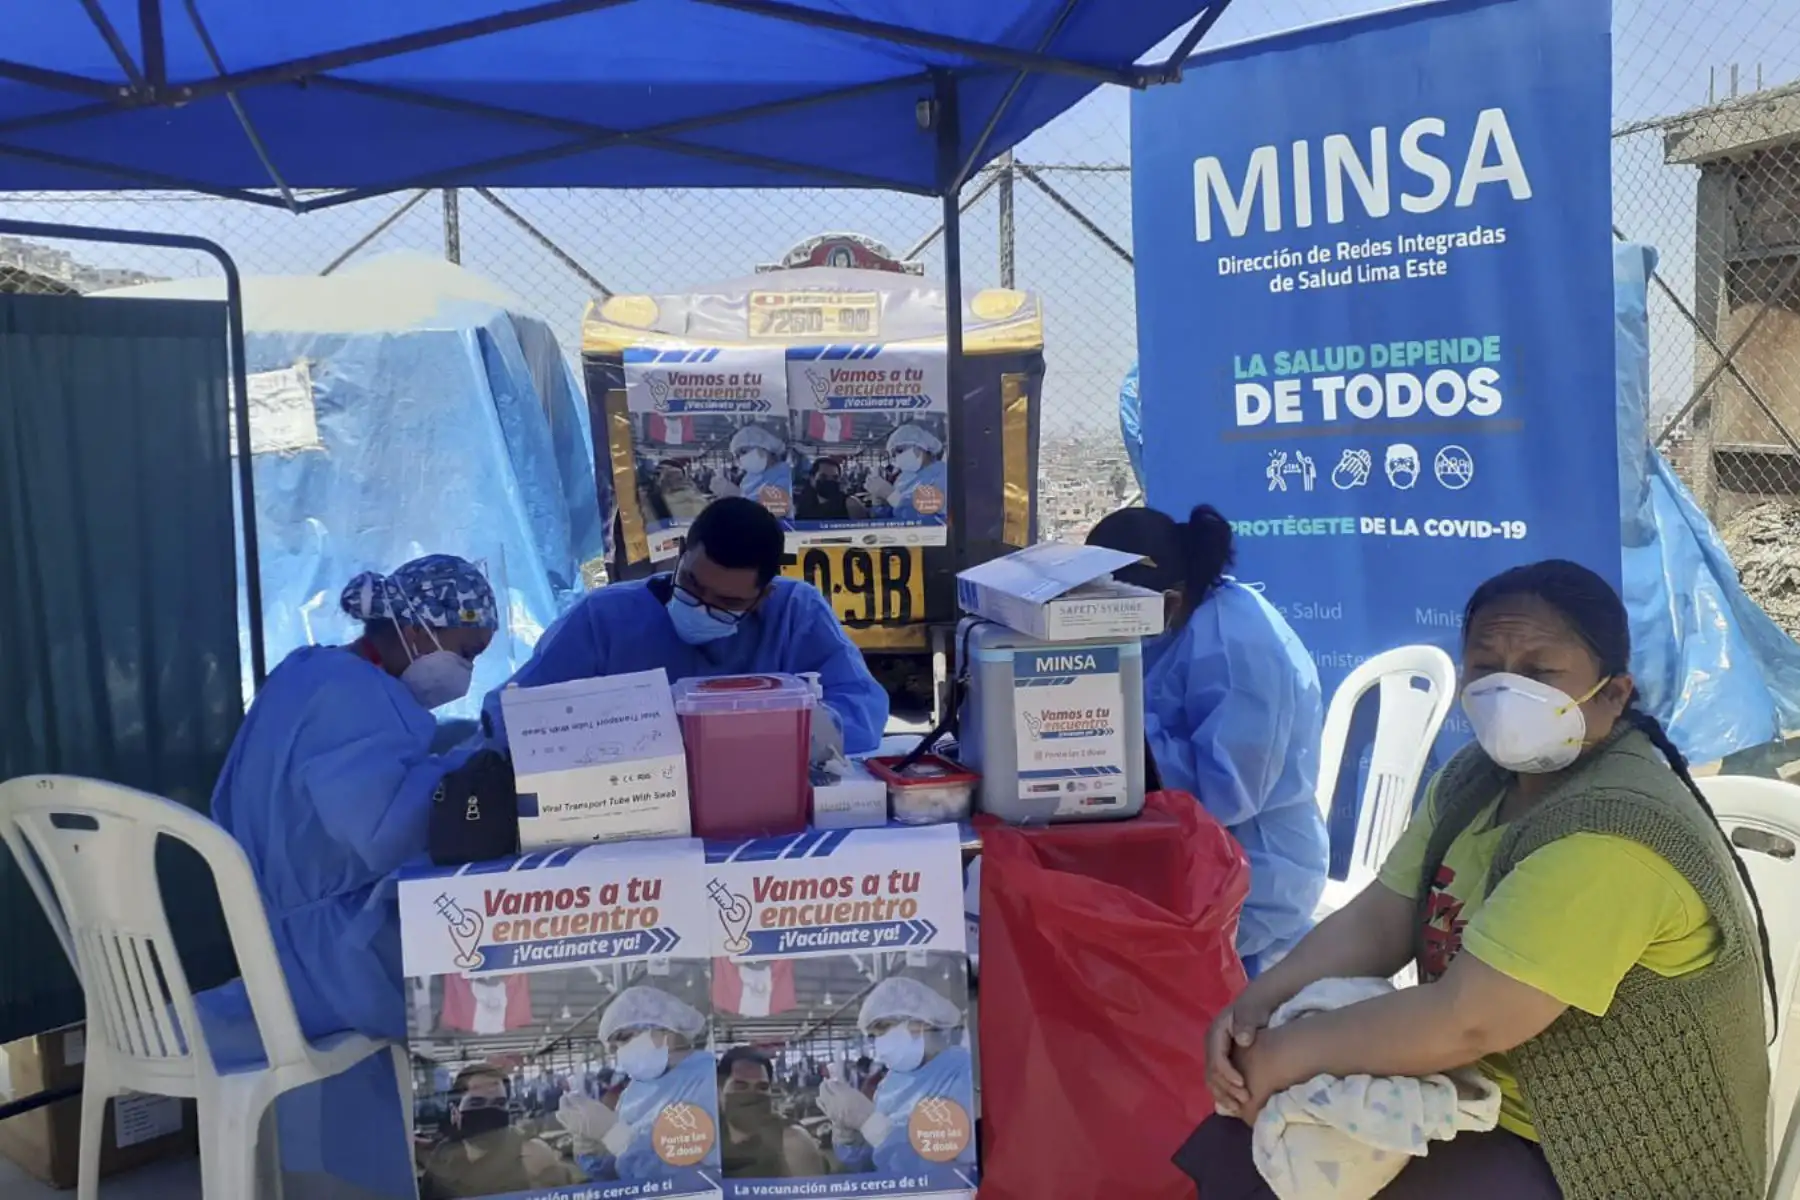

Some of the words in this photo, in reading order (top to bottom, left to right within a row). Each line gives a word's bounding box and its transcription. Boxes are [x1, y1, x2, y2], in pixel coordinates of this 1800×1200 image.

[1193, 107, 1533, 242] MINSA
[1218, 248, 1302, 275] Dirección
[1307, 246, 1331, 264] de
[1337, 239, 1392, 261] Redes
[1398, 226, 1506, 255] Integradas
[1269, 274, 1294, 293] de
[1298, 266, 1353, 290] Salud
[1357, 263, 1400, 284] Lima
[1406, 258, 1448, 278] Este
[1234, 353, 1268, 379] LA
[1273, 345, 1366, 376] SALUD
[1370, 336, 1501, 368] DEPENDE
[667, 371, 725, 386] Vamos
[728, 373, 739, 385] a
[743, 371, 763, 386] tu
[830, 368, 886, 383] Vamos
[890, 369, 901, 381] a
[905, 367, 923, 381] tu
[673, 385, 760, 399] encuentro
[834, 381, 921, 396] encuentro
[1235, 379, 1304, 427] DE
[1312, 367, 1502, 420] TODOS
[1360, 516, 1386, 535] DE
[1390, 518, 1420, 536] LA
[1424, 519, 1527, 539] COVID-19
[1293, 602, 1343, 620] Salud
[1415, 608, 1464, 628] Minis
[1035, 654, 1097, 673] MINSA
[1309, 650, 1368, 669] iniste
[1041, 709, 1082, 721] Vamos
[1085, 710, 1094, 719] a
[1096, 707, 1111, 718] tu
[1044, 718, 1109, 731] encuentro
[542, 803, 563, 813] Viral
[565, 797, 607, 812] Transport
[609, 795, 631, 808] Tube
[632, 792, 651, 804] With
[653, 788, 677, 800] Swab
[484, 887, 591, 918] Vamos
[599, 883, 619, 903] a
[627, 876, 662, 902] tu
[753, 873, 854, 903] Vamos
[861, 873, 881, 896] a
[887, 869, 921, 893] tu
[760, 897, 918, 928] encuentro
[492, 905, 659, 943] encuentro
[779, 928, 873, 952] ¡Vacúnate
[872, 924, 900, 946] ya!
[512, 939, 607, 966] ¡Vacúnate
[612, 934, 641, 957] ya!
[660, 1135, 693, 1147] Ponte
[917, 1130, 946, 1140] Ponte
[921, 1140, 931, 1152] 2
[666, 1146, 676, 1157] 2
[572, 1187, 601, 1200] más
[603, 1183, 639, 1198] cerca
[643, 1181, 658, 1194] de
[662, 1178, 673, 1191] ti
[734, 1184, 749, 1196] La
[753, 1179, 827, 1196] vacunación
[830, 1181, 858, 1192] más
[861, 1178, 896, 1191] cerca
[900, 1176, 917, 1188] de
[919, 1174, 929, 1187] ti
